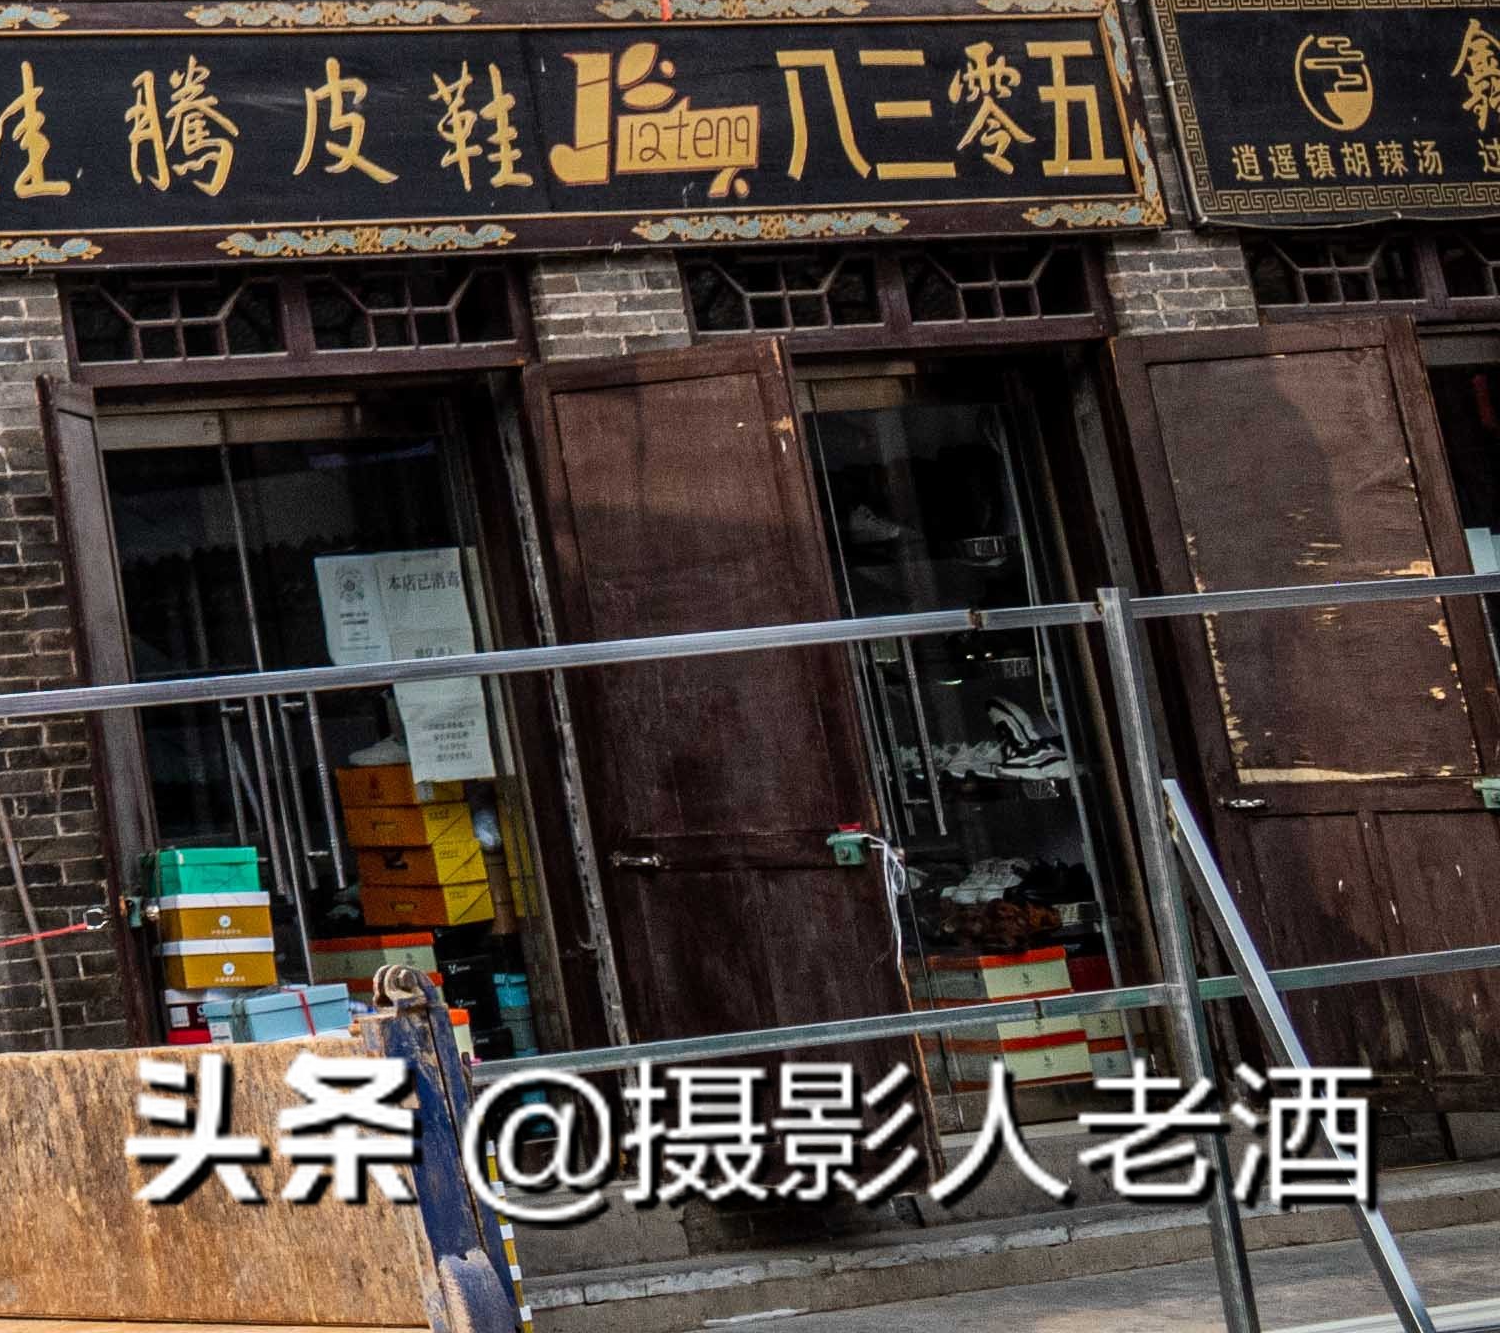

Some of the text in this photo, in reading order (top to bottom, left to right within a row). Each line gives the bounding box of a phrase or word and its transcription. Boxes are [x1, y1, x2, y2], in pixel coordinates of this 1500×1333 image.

[775, 39, 1125, 181] 八三零五
[1232, 139, 1443, 182] 逍遥镇胡辣汤
